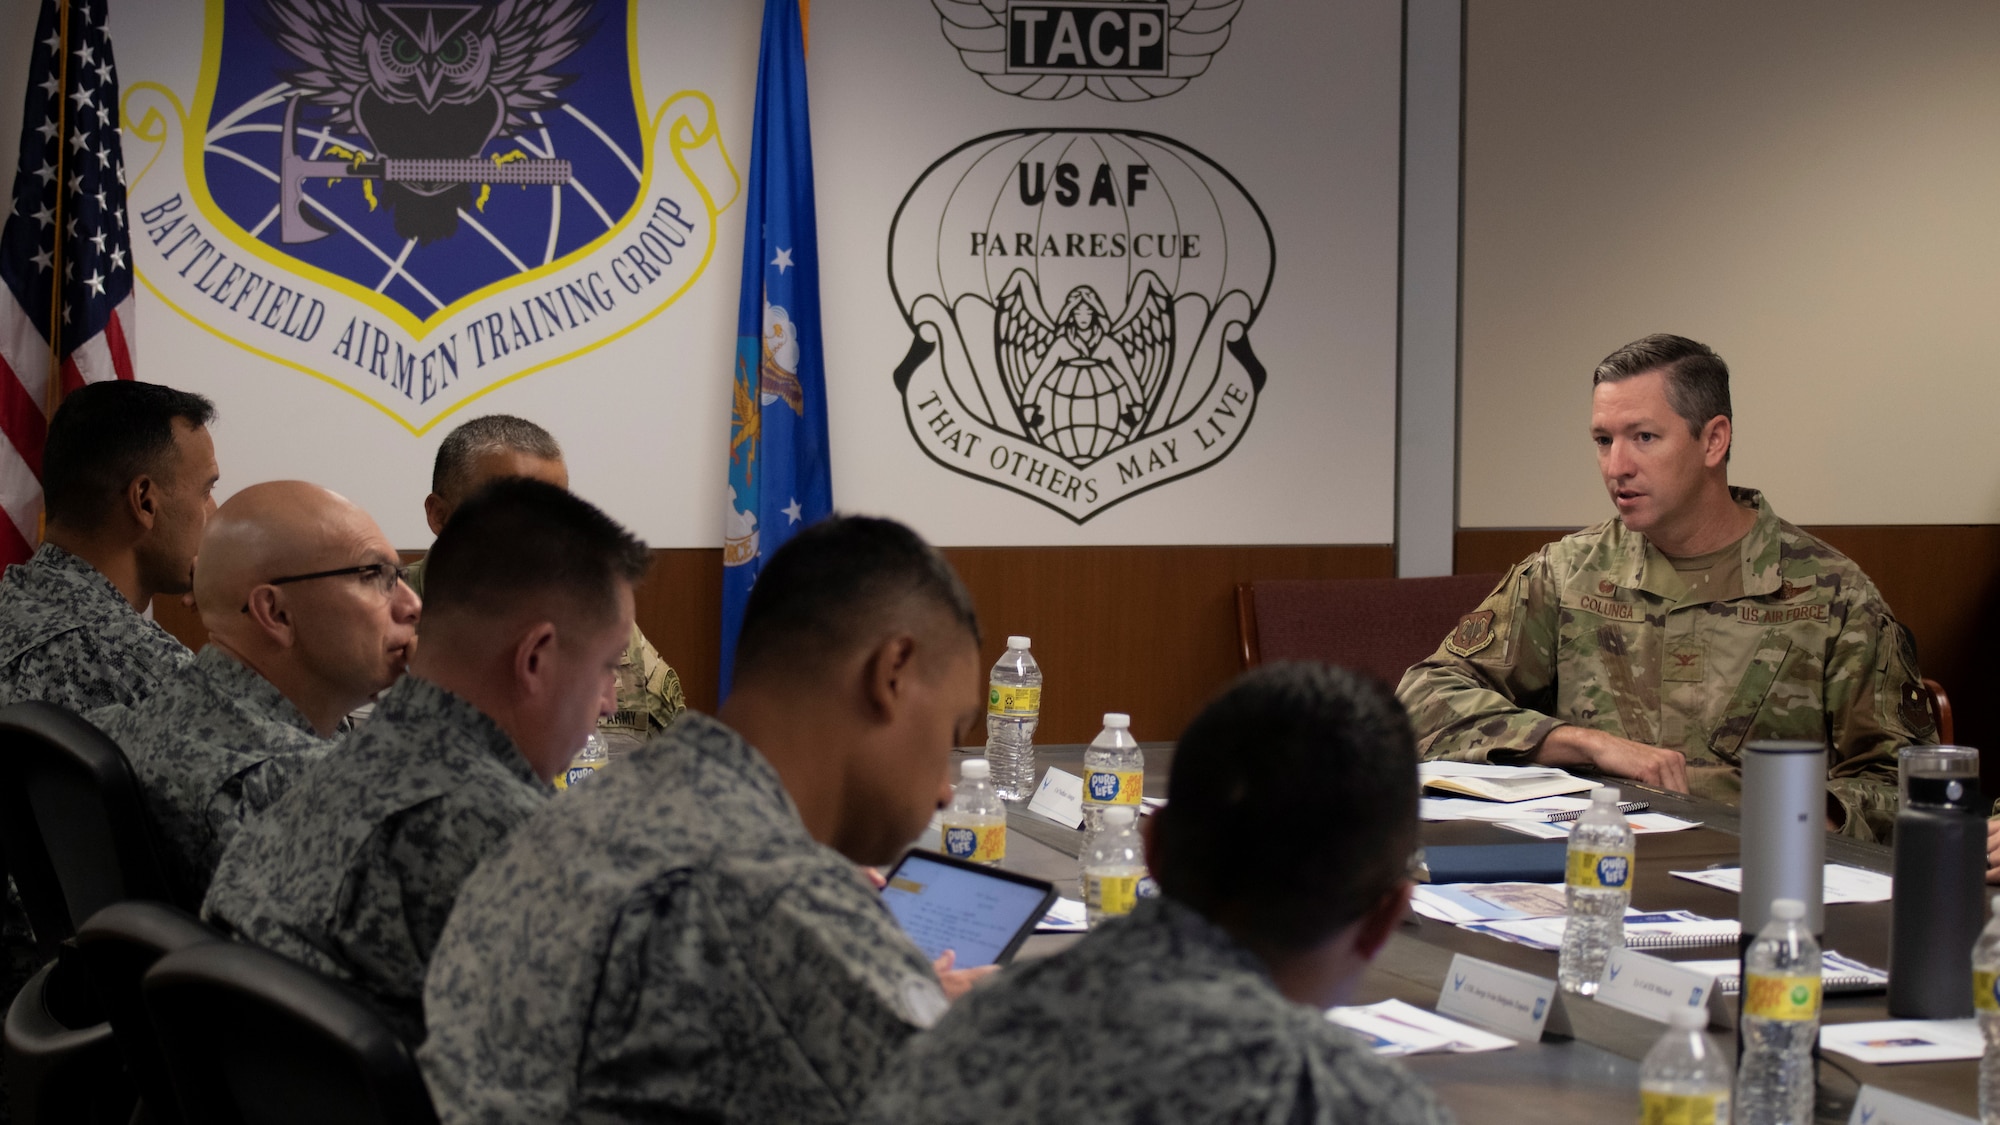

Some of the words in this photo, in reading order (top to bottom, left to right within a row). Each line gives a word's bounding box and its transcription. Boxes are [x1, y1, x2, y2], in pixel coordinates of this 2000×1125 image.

[1013, 10, 1163, 67] TACP
[1018, 161, 1150, 208] USAF
[969, 232, 1201, 259] PARARESCUE
[140, 193, 326, 344] BATTLEFIELD
[332, 315, 458, 405] AIRMEN
[466, 271, 617, 370] TRAINING
[609, 195, 695, 295] GROUP
[917, 390, 982, 458] THAT
[989, 445, 1100, 503] OTHERS
[1116, 438, 1180, 485] MAY
[1193, 383, 1249, 450] LIVE
[1580, 595, 1634, 619] COLUNGA
[1742, 607, 1759, 622] US
[1763, 609, 1783, 623] AIR
[1786, 605, 1825, 619] FORCE
[607, 711, 636, 726] ARMY
